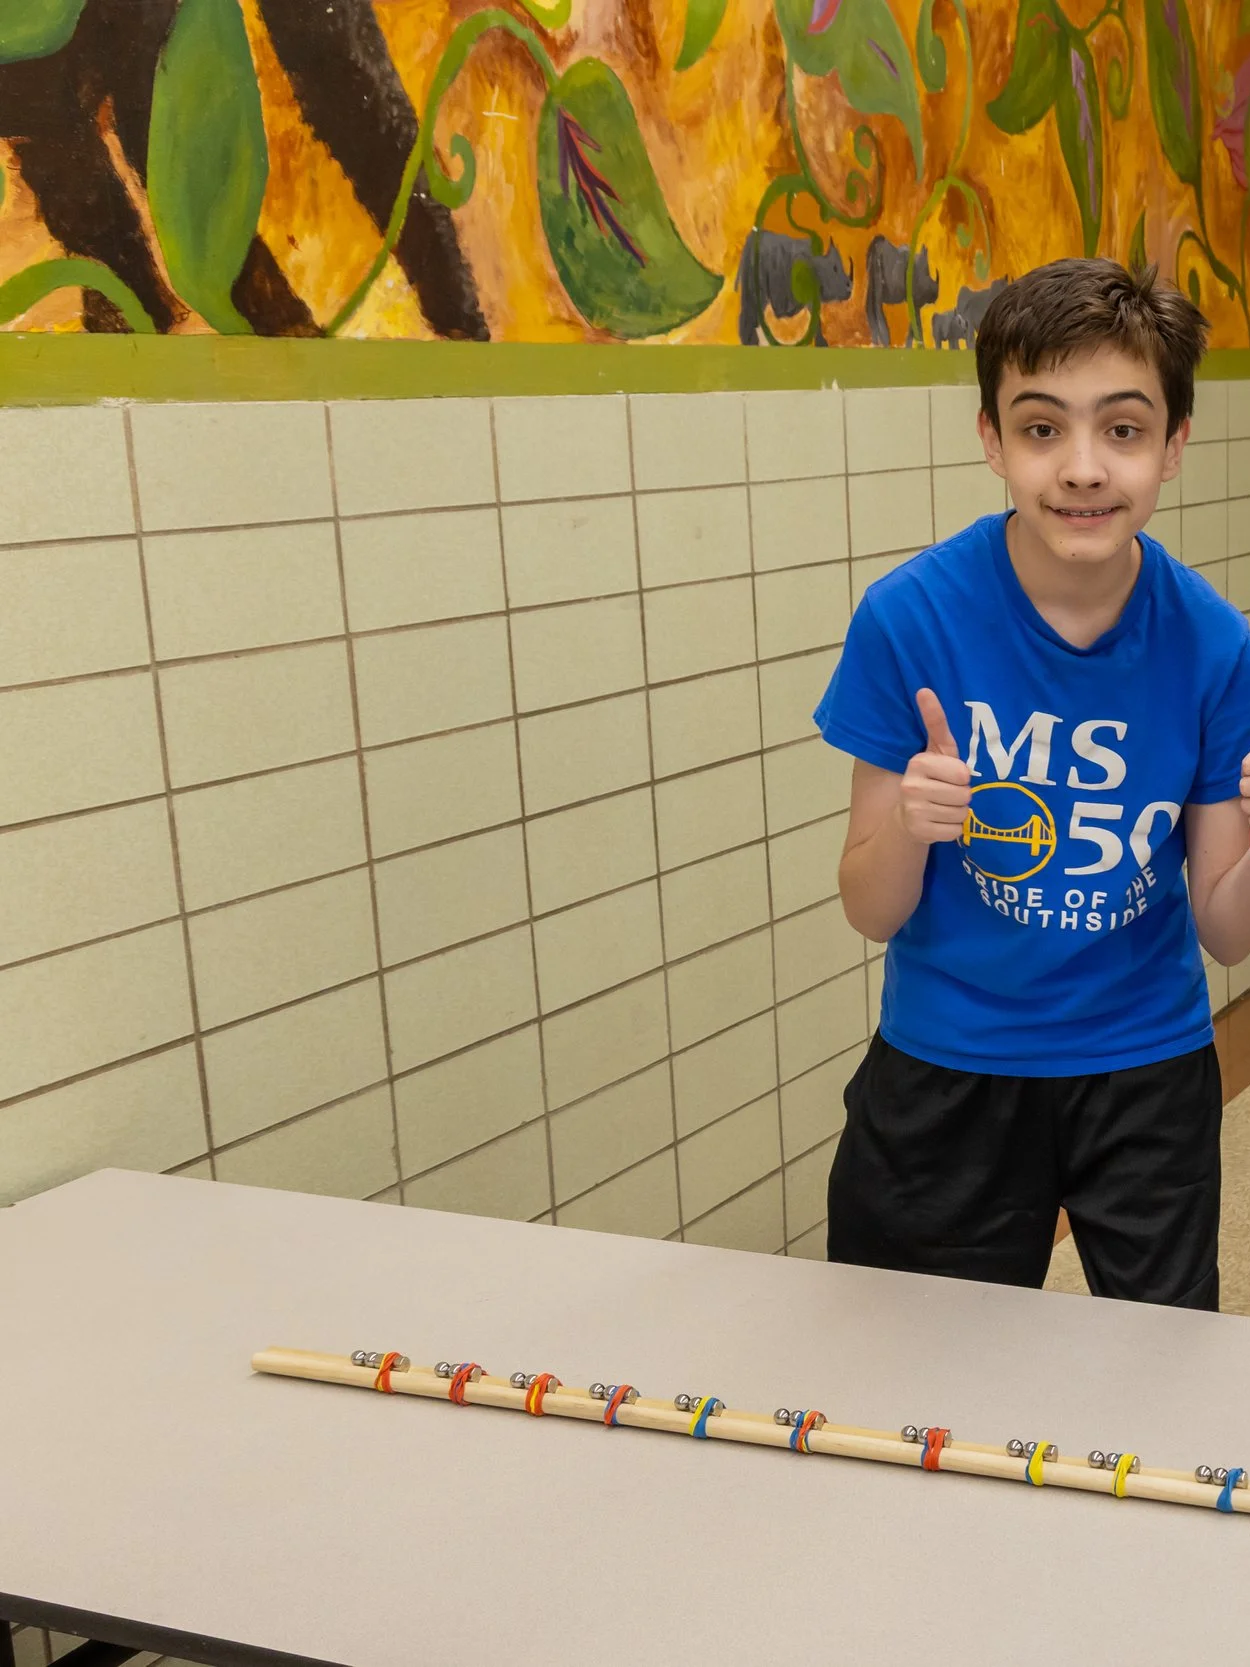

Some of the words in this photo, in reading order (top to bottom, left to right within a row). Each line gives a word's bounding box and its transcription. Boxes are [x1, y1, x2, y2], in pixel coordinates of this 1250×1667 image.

[964, 701, 1128, 790] MS
[1064, 801, 1181, 875] 50
[980, 889, 1148, 931] SOUTHSIDE
[1064, 889, 1107, 909] OF
